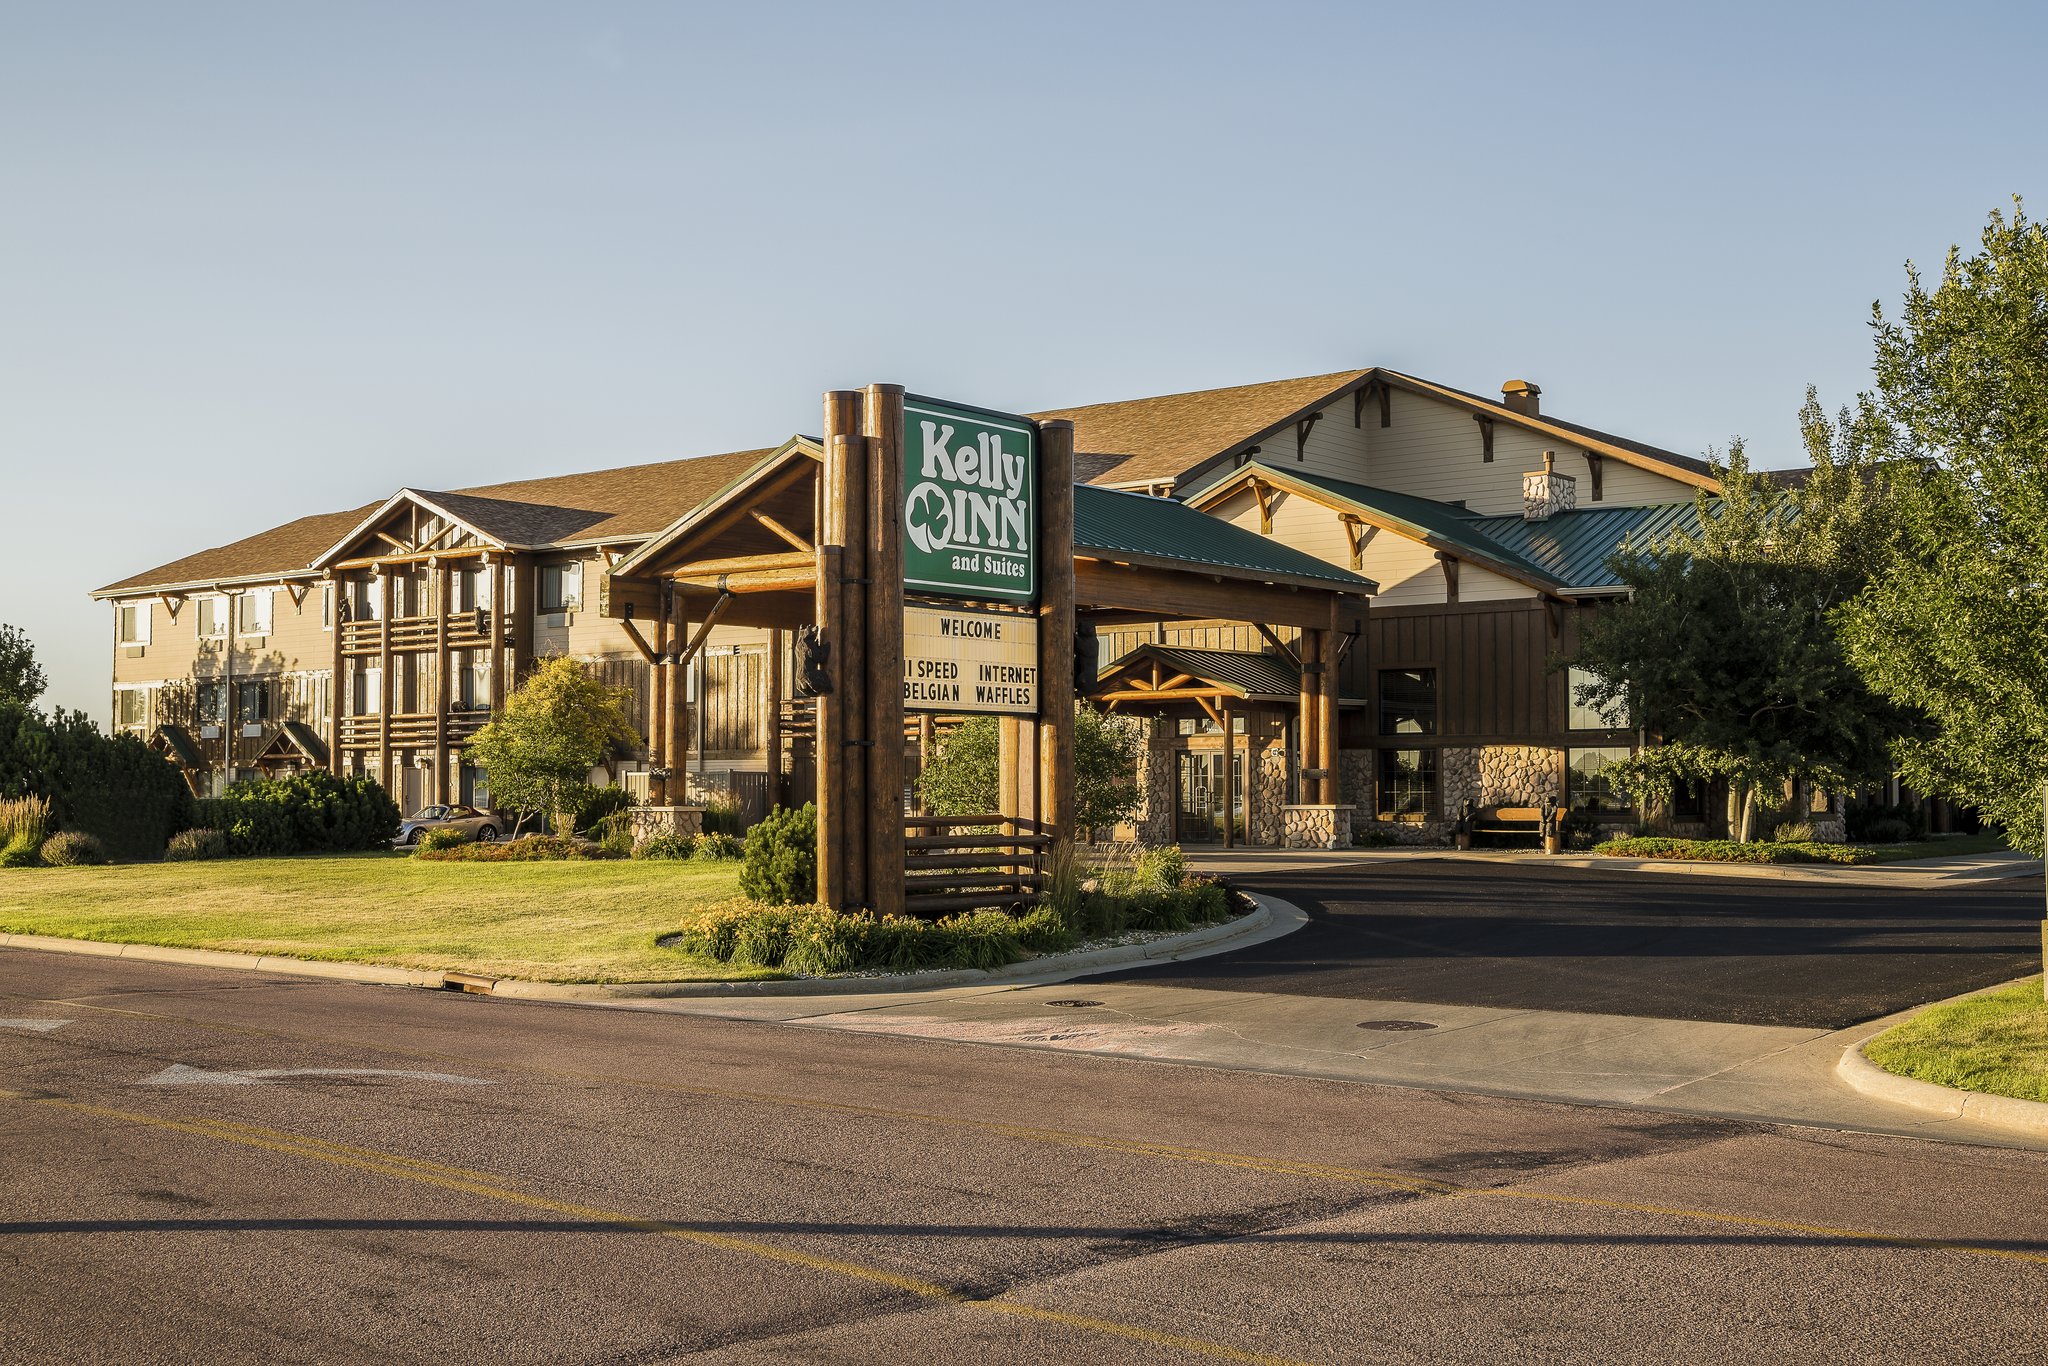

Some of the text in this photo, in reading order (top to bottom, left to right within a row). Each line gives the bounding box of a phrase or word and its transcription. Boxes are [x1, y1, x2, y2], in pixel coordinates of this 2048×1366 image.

[920, 420, 1025, 499] Kelly
[952, 489, 1028, 551] INN
[952, 553, 1025, 578] and Suites
[940, 617, 1001, 640] WELCOME
[903, 659, 1036, 684] I SPEED INTERNET
[903, 681, 1030, 705] BELGIAN WAFFLES
